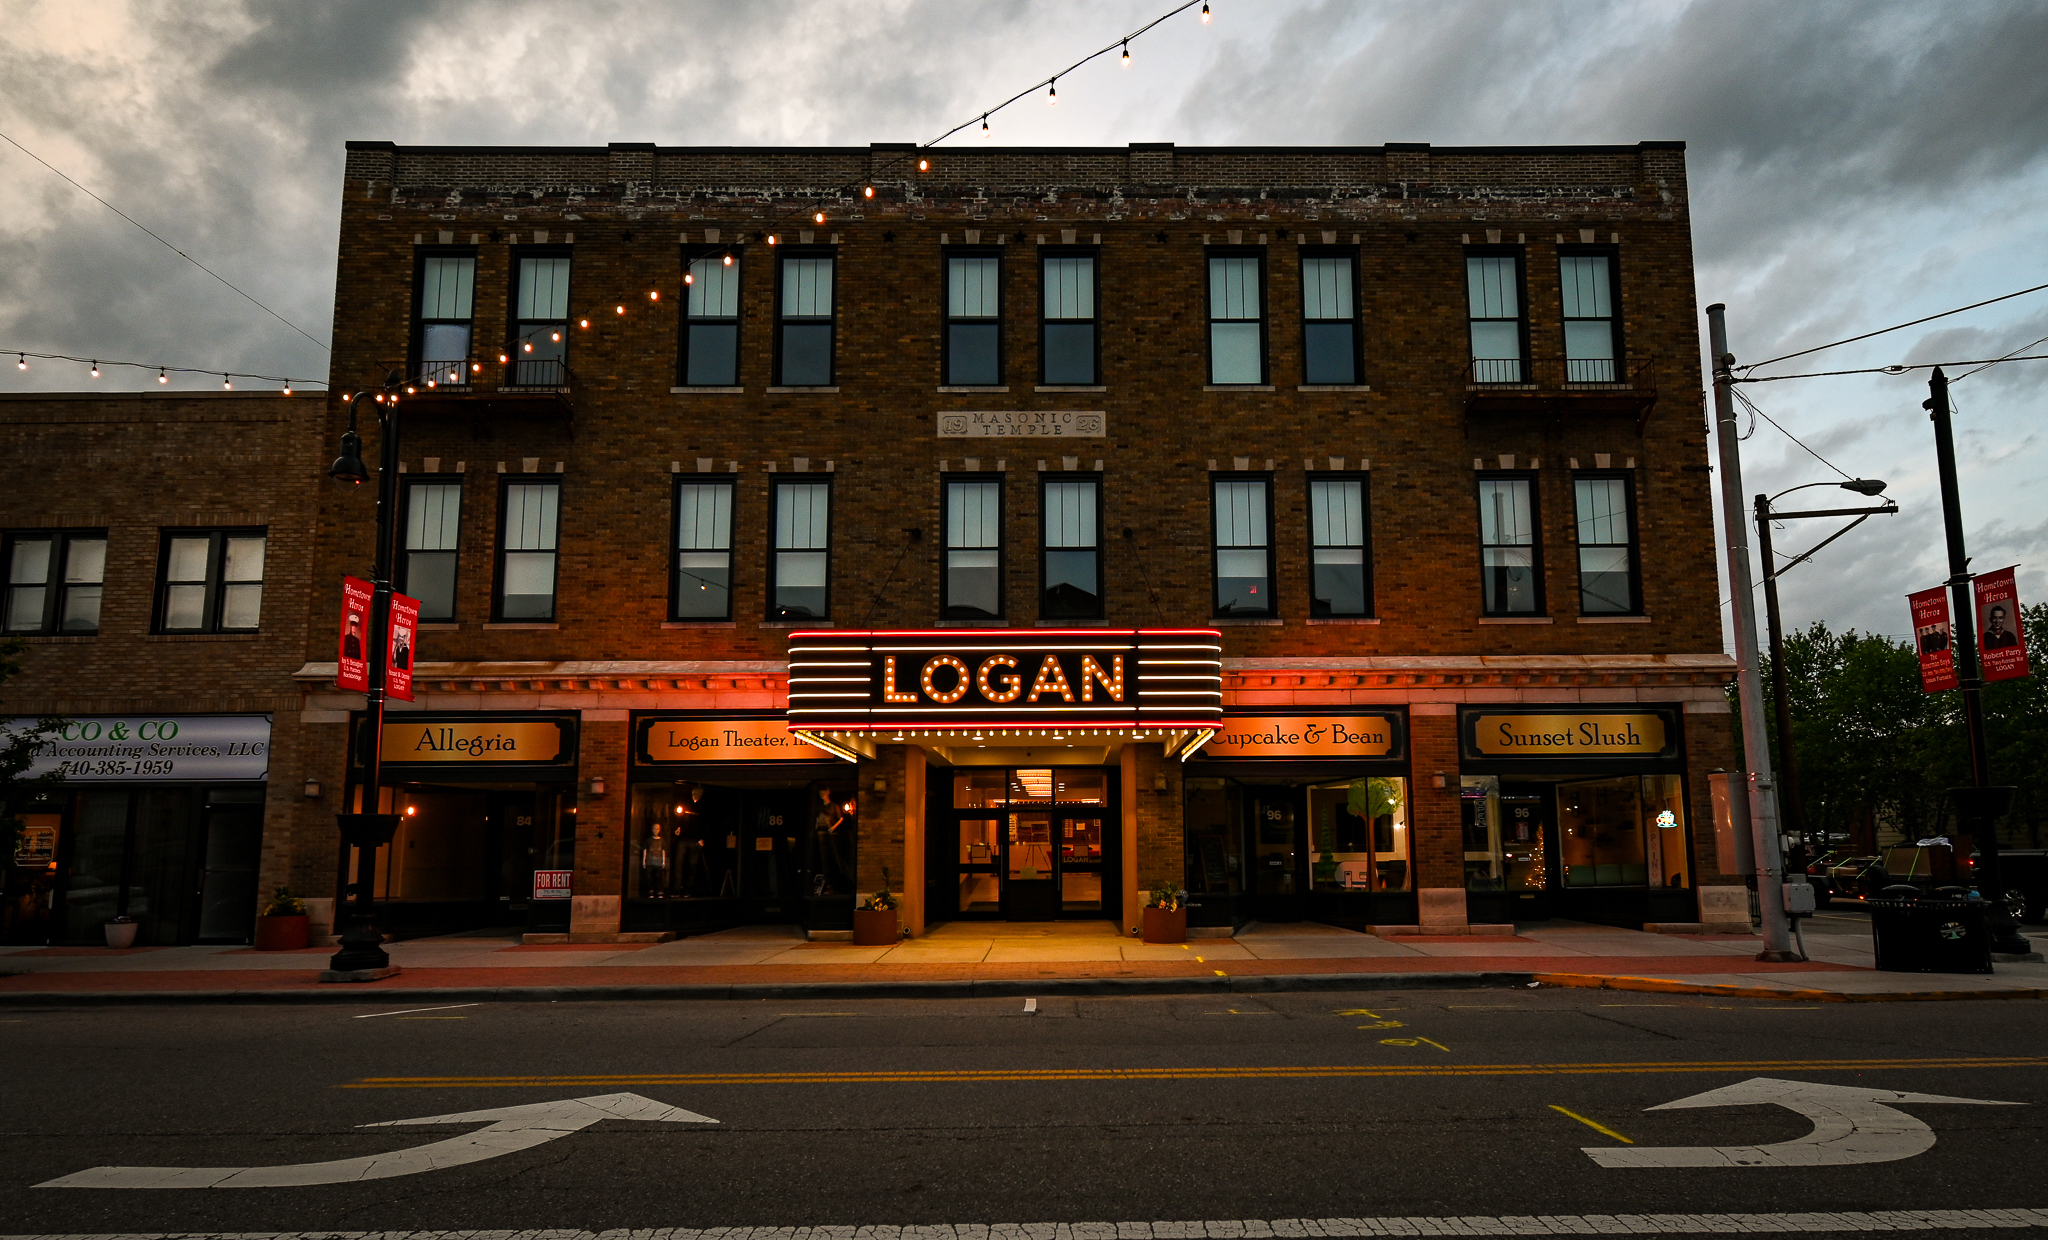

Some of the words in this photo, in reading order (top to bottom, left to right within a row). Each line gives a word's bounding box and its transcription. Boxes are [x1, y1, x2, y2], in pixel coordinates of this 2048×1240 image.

[945, 418, 964, 432] 19
[972, 413, 1071, 424] MASONIC
[1078, 418, 1100, 432] 26
[982, 425, 1062, 435] TEMPLE
[344, 583, 371, 602] Hometown
[1975, 577, 2014, 593] Hometown
[392, 599, 418, 617] Hometown
[1911, 595, 1946, 610] Hometown
[1983, 651, 2004, 661] Robert
[1996, 664, 2015, 672] LOGAN
[884, 654, 1124, 704] LOGAN
[62, 720, 102, 742] CO
[108, 720, 130, 742] &
[139, 720, 179, 742] CO
[1304, 724, 1328, 745] &
[1331, 724, 1385, 745] Bean
[1499, 722, 1574, 747] Sunset
[1579, 721, 1642, 746] Slush
[414, 727, 517, 757] Allegria
[668, 731, 719, 751] Logan
[723, 730, 789, 748] Theater,
[46, 741, 143, 760] Accounting
[148, 741, 221, 758] Services,
[227, 741, 265, 757] LLC
[60, 759, 174, 776] 740-385-1959
[768, 814, 783, 826] 86
[1266, 809, 1281, 821] 96
[1515, 807, 1530, 818] 96
[516, 815, 532, 826] 84
[537, 873, 551, 888] FOR
[552, 873, 571, 888] RENT
